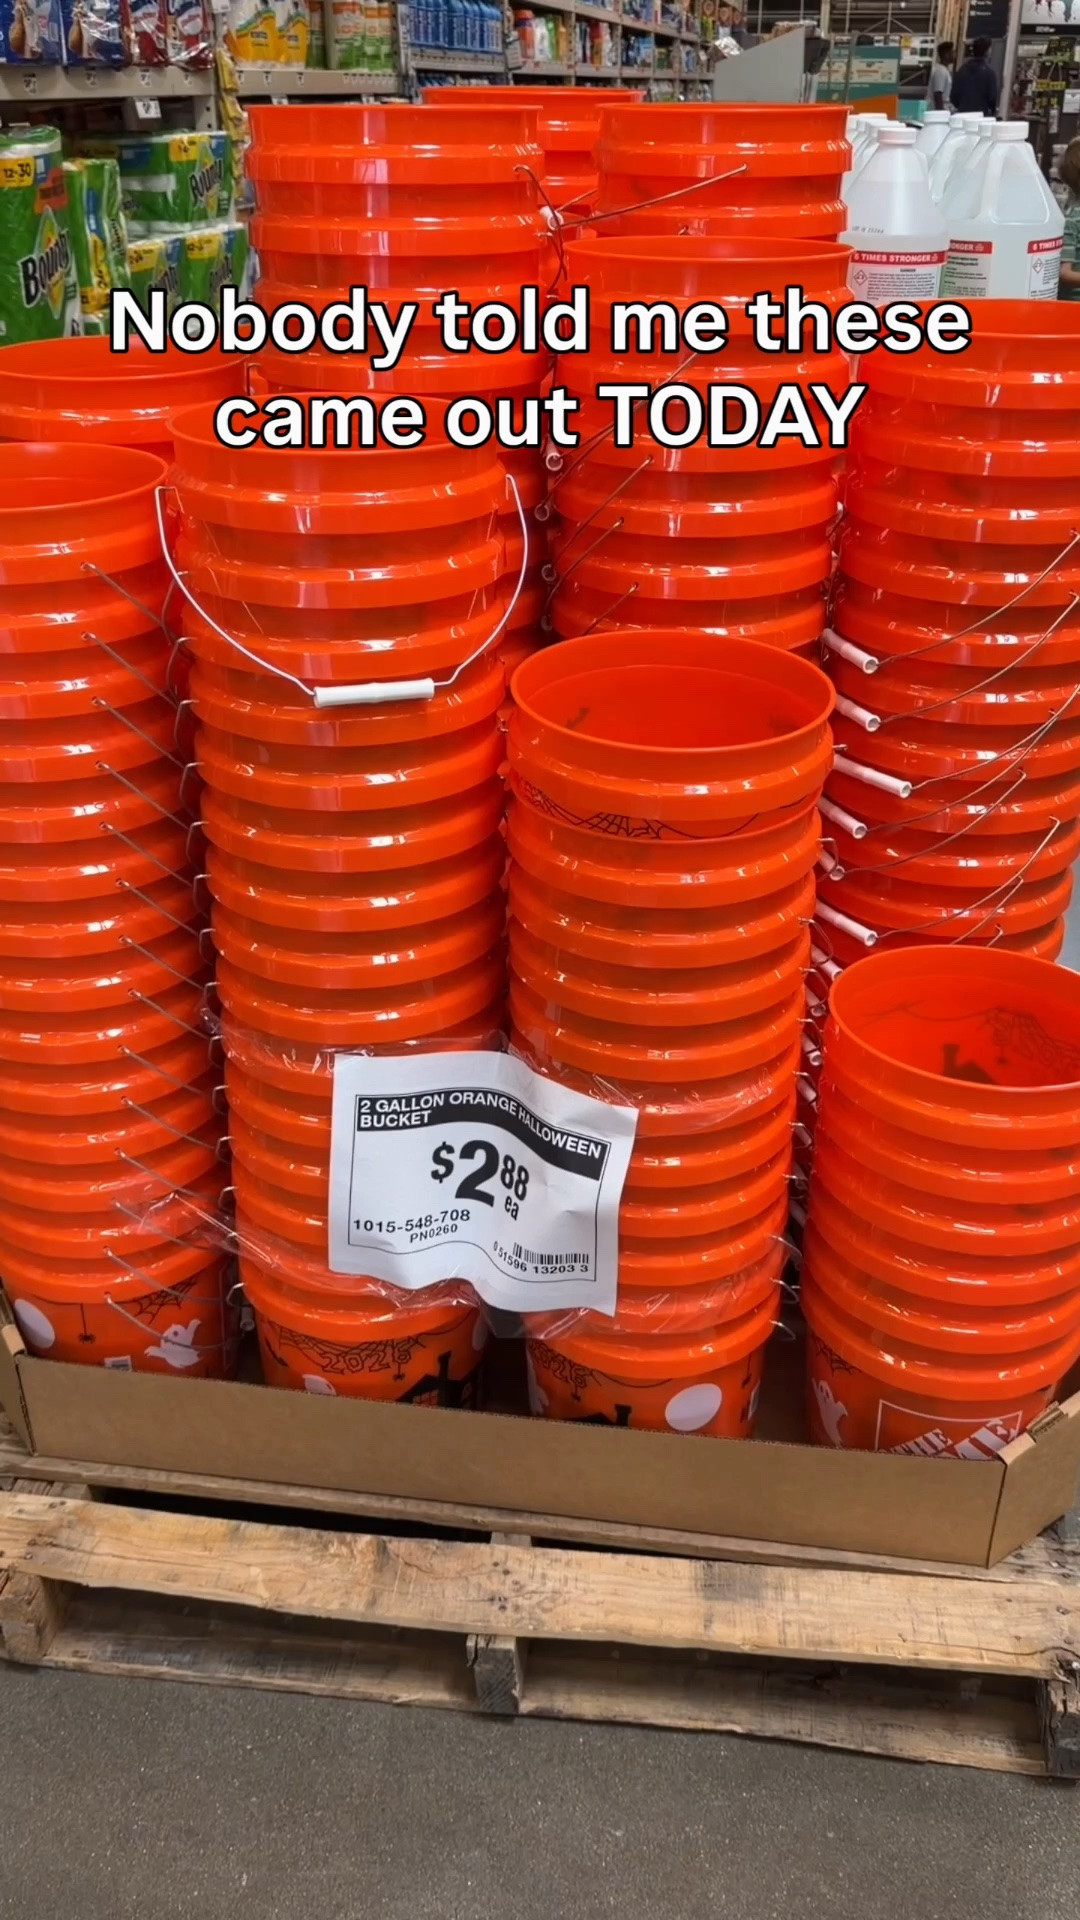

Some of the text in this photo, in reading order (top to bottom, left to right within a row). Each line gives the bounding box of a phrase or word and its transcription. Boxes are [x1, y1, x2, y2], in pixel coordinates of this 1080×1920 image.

[20, 231, 71, 306] Bounty
[861, 253, 888, 262] TIMES
[889, 253, 931, 263] STRONGER
[360, 1110, 432, 1128] BUCKET
[360, 1091, 602, 1160] 2 GALLON ORANGE HALLOWEEN
[354, 1209, 471, 1234] 1015-548-708
[504, 1196, 519, 1222] ea
[410, 1223, 458, 1244] PN0260
[498, 1250, 528, 1273] 51596
[533, 1264, 576, 1275] 13203
[580, 1264, 589, 1273] 3
[320, 1337, 412, 1375] 2026
